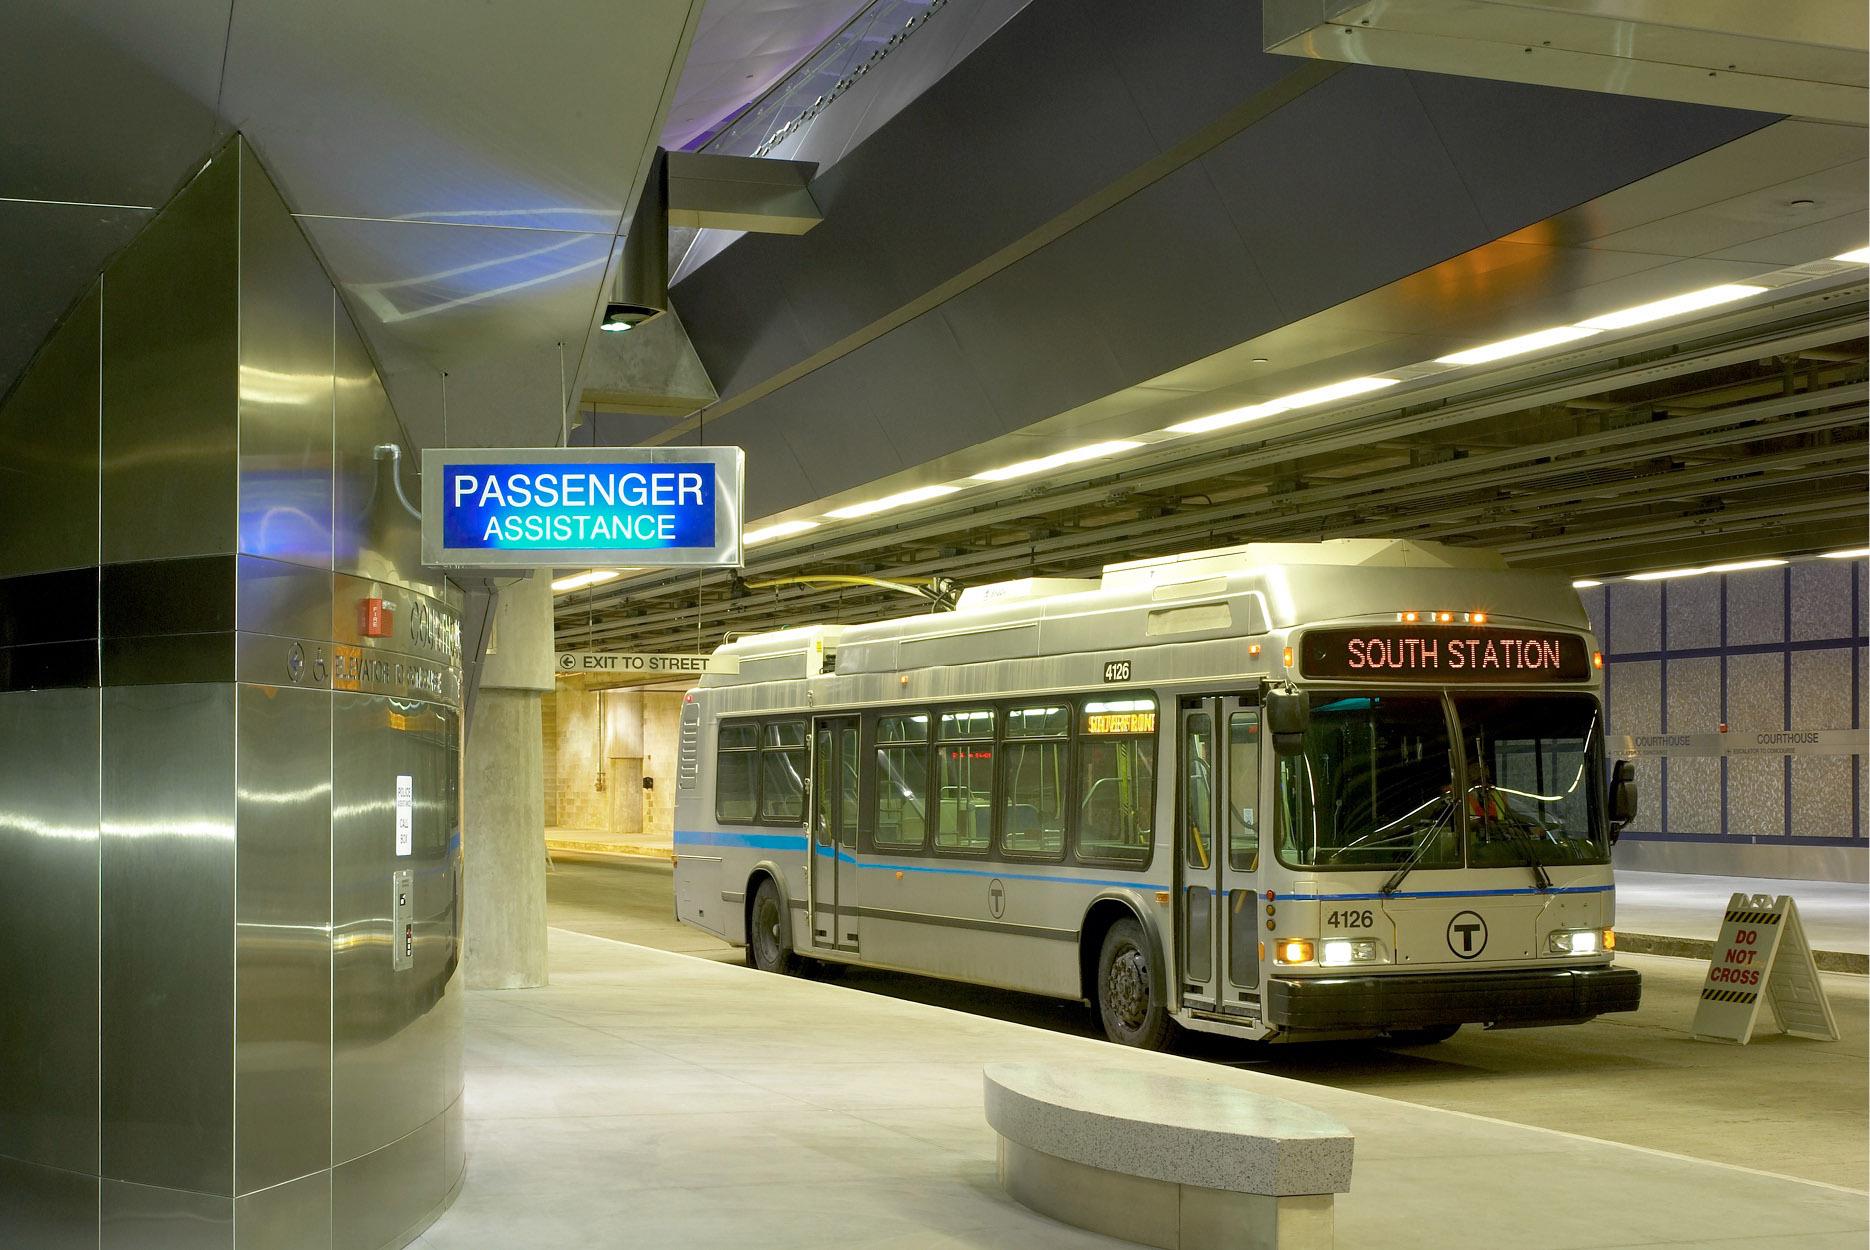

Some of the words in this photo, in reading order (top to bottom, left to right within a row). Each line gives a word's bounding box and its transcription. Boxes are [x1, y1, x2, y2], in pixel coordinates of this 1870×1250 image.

[454, 472, 704, 508] PASSENGER
[483, 514, 676, 541] ASSISTANCE
[1348, 638, 1438, 669] SOUTH
[1448, 638, 1561, 669] STATION
[335, 655, 390, 684] ELEVATOR
[394, 663, 404, 685] TO
[583, 655, 618, 669] EXIT
[622, 656, 644, 669] TO
[649, 657, 710, 671] STREET
[1105, 662, 1130, 680] 4126
[1635, 735, 1691, 747] COURTHOUSE
[1757, 733, 1820, 745] COURTHOUSE
[1327, 910, 1374, 929] 4126
[1735, 930, 1757, 944] DO
[1725, 949, 1757, 964] NOT
[1710, 967, 1759, 985] CROSS
